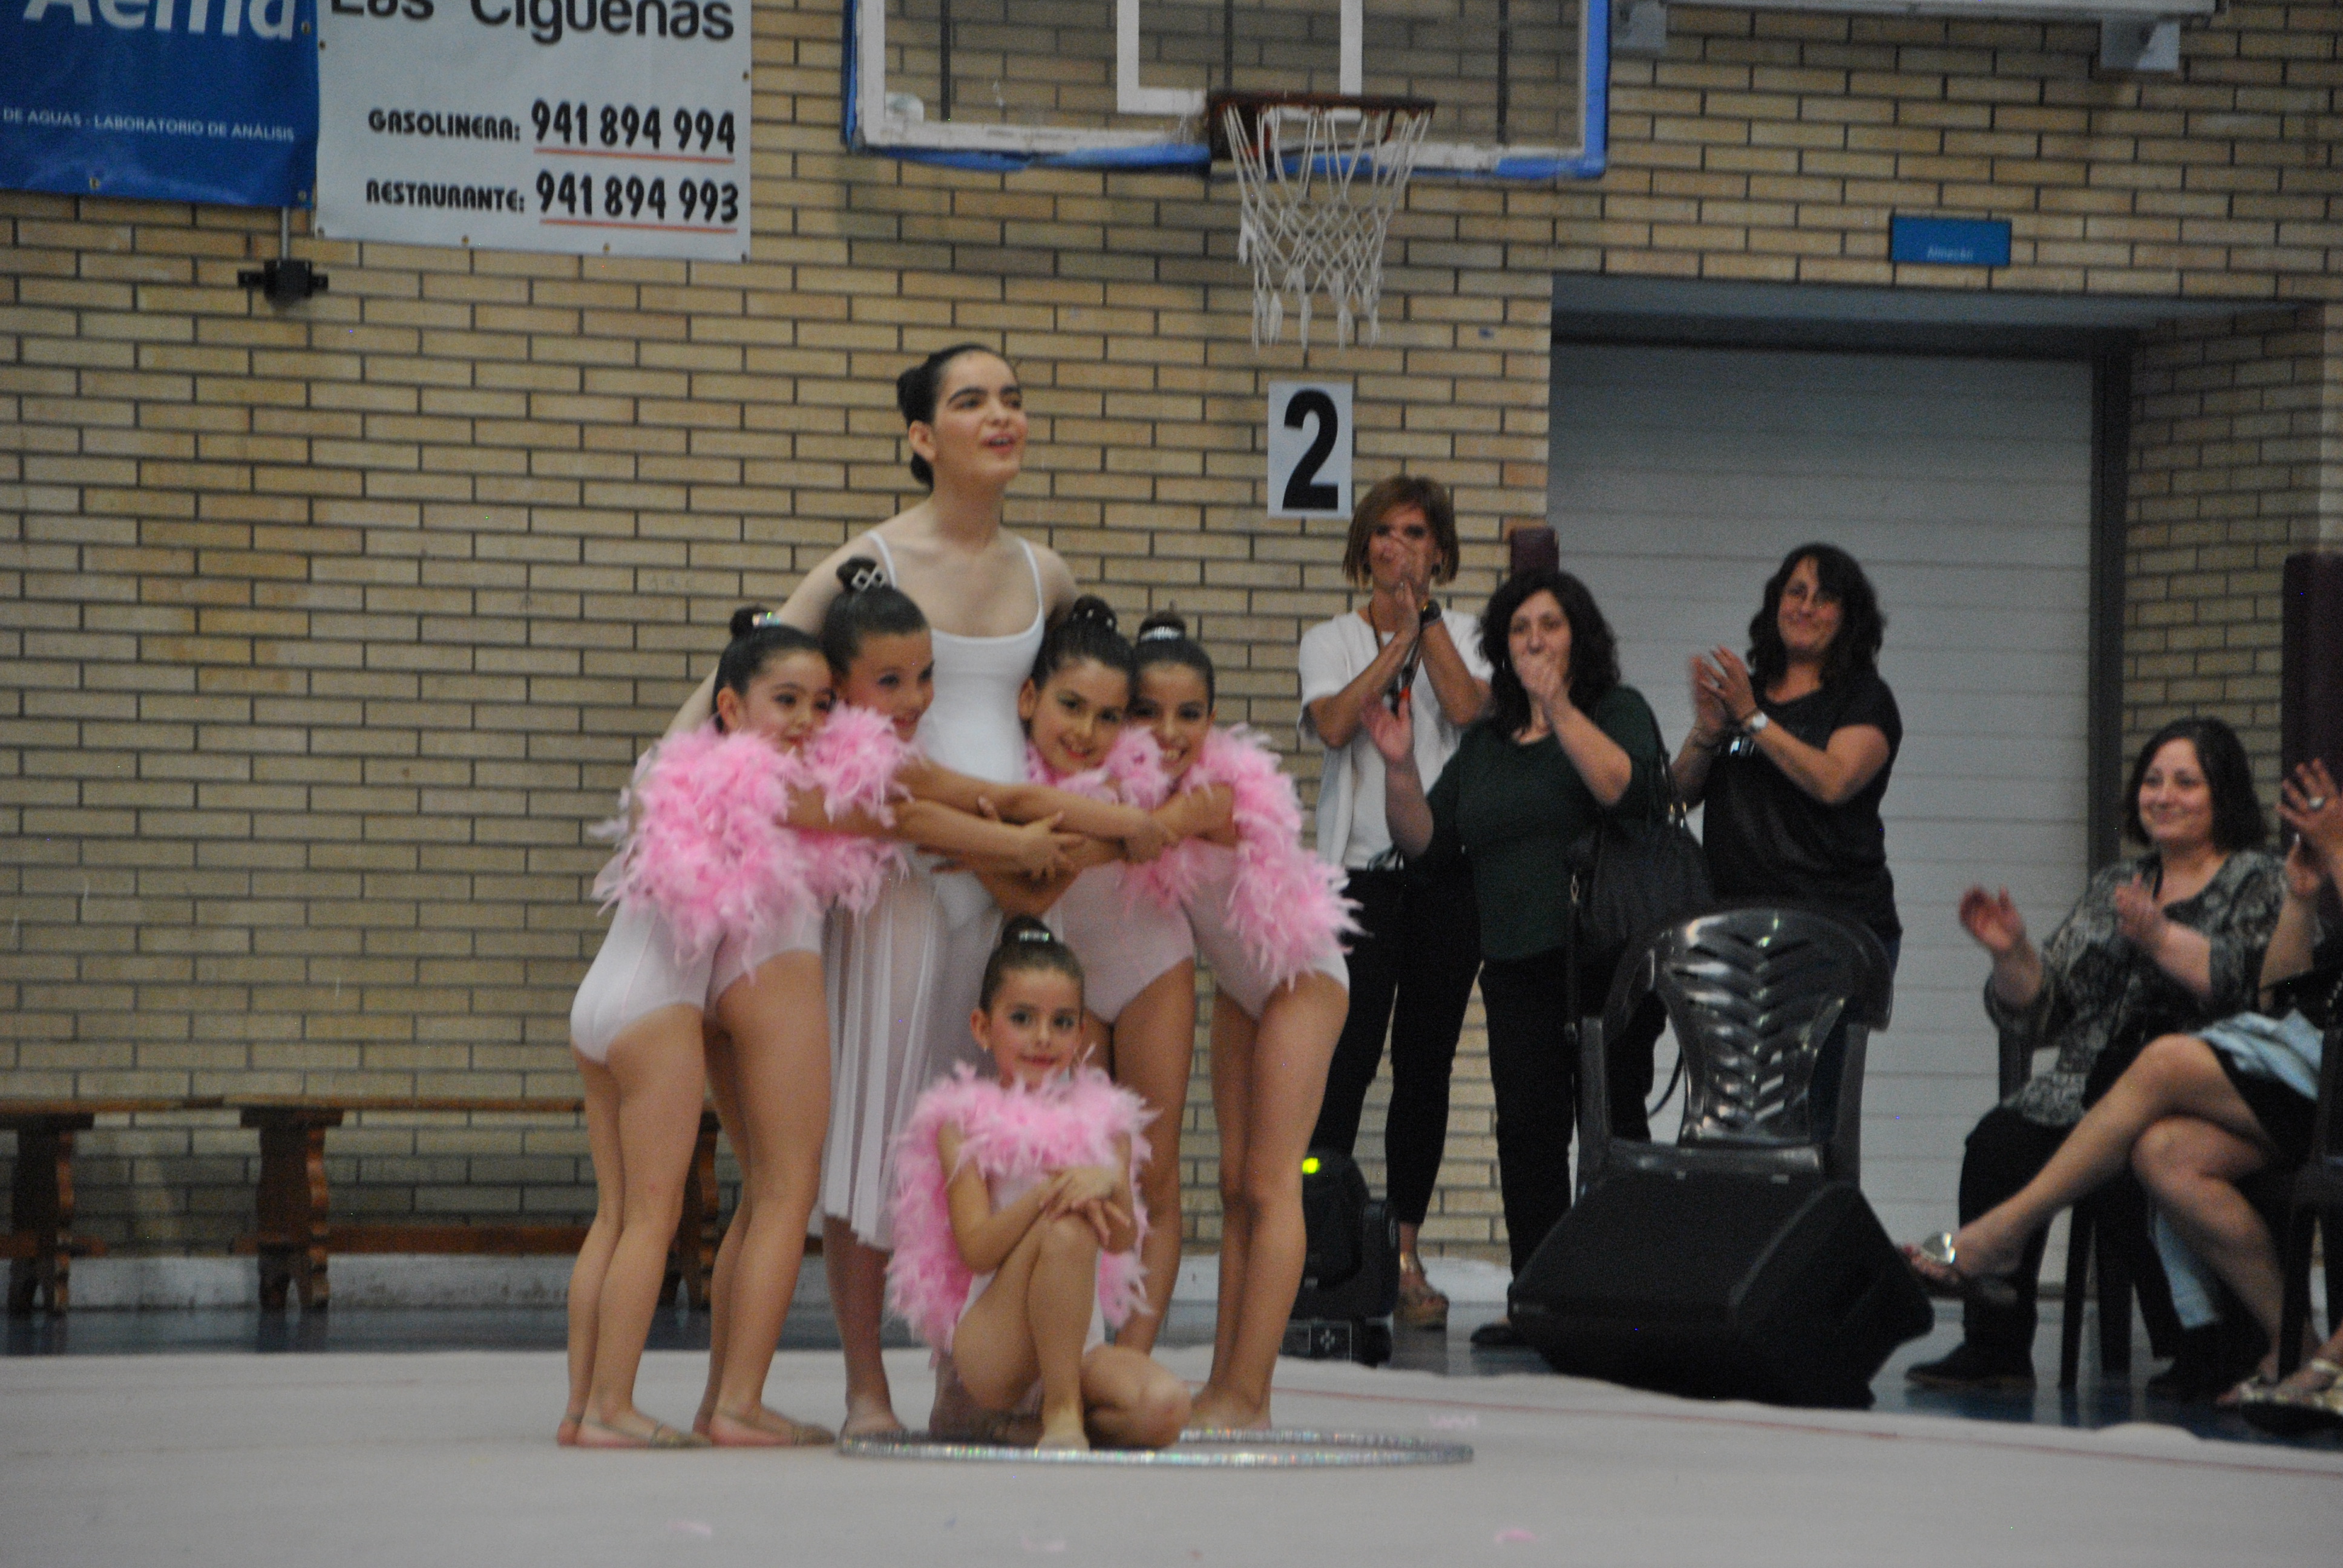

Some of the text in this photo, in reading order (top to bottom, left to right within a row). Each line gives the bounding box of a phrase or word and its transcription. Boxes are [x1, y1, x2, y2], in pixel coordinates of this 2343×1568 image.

[4, 106, 23, 123] DE
[28, 109, 82, 127] AGUAS
[95, 114, 203, 136] LABORATORIO
[208, 122, 227, 137] DE
[368, 99, 735, 154] GASOLINERA: 941 894 994
[366, 169, 738, 223] RESTAURANTE: 941 894 993
[1282, 388, 1339, 511] 2
